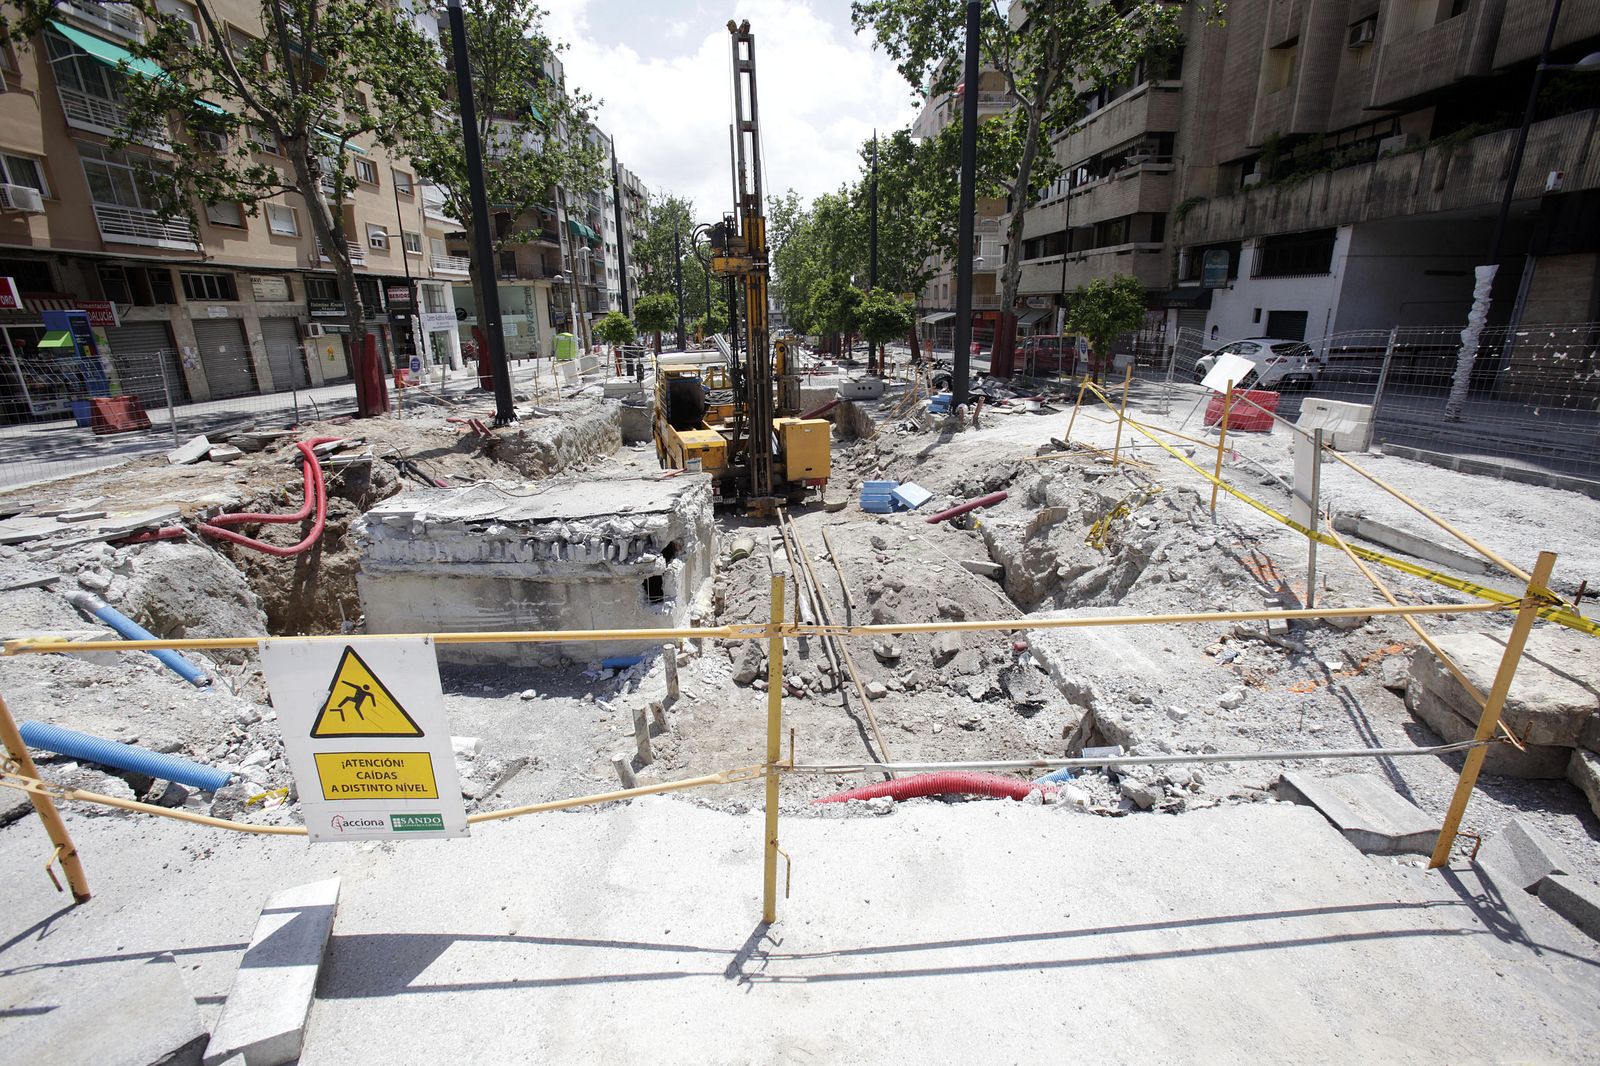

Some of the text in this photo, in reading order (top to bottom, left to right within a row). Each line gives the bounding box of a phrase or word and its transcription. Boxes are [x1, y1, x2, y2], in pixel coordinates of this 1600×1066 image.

[87, 309, 114, 321] DALUCÍA
[341, 758, 404, 769] ¡ATENCIÓN!
[356, 770, 398, 780] CAÍDAS
[331, 784, 339, 792] A
[342, 784, 393, 792] DISTINTO
[343, 819, 384, 827] acciona
